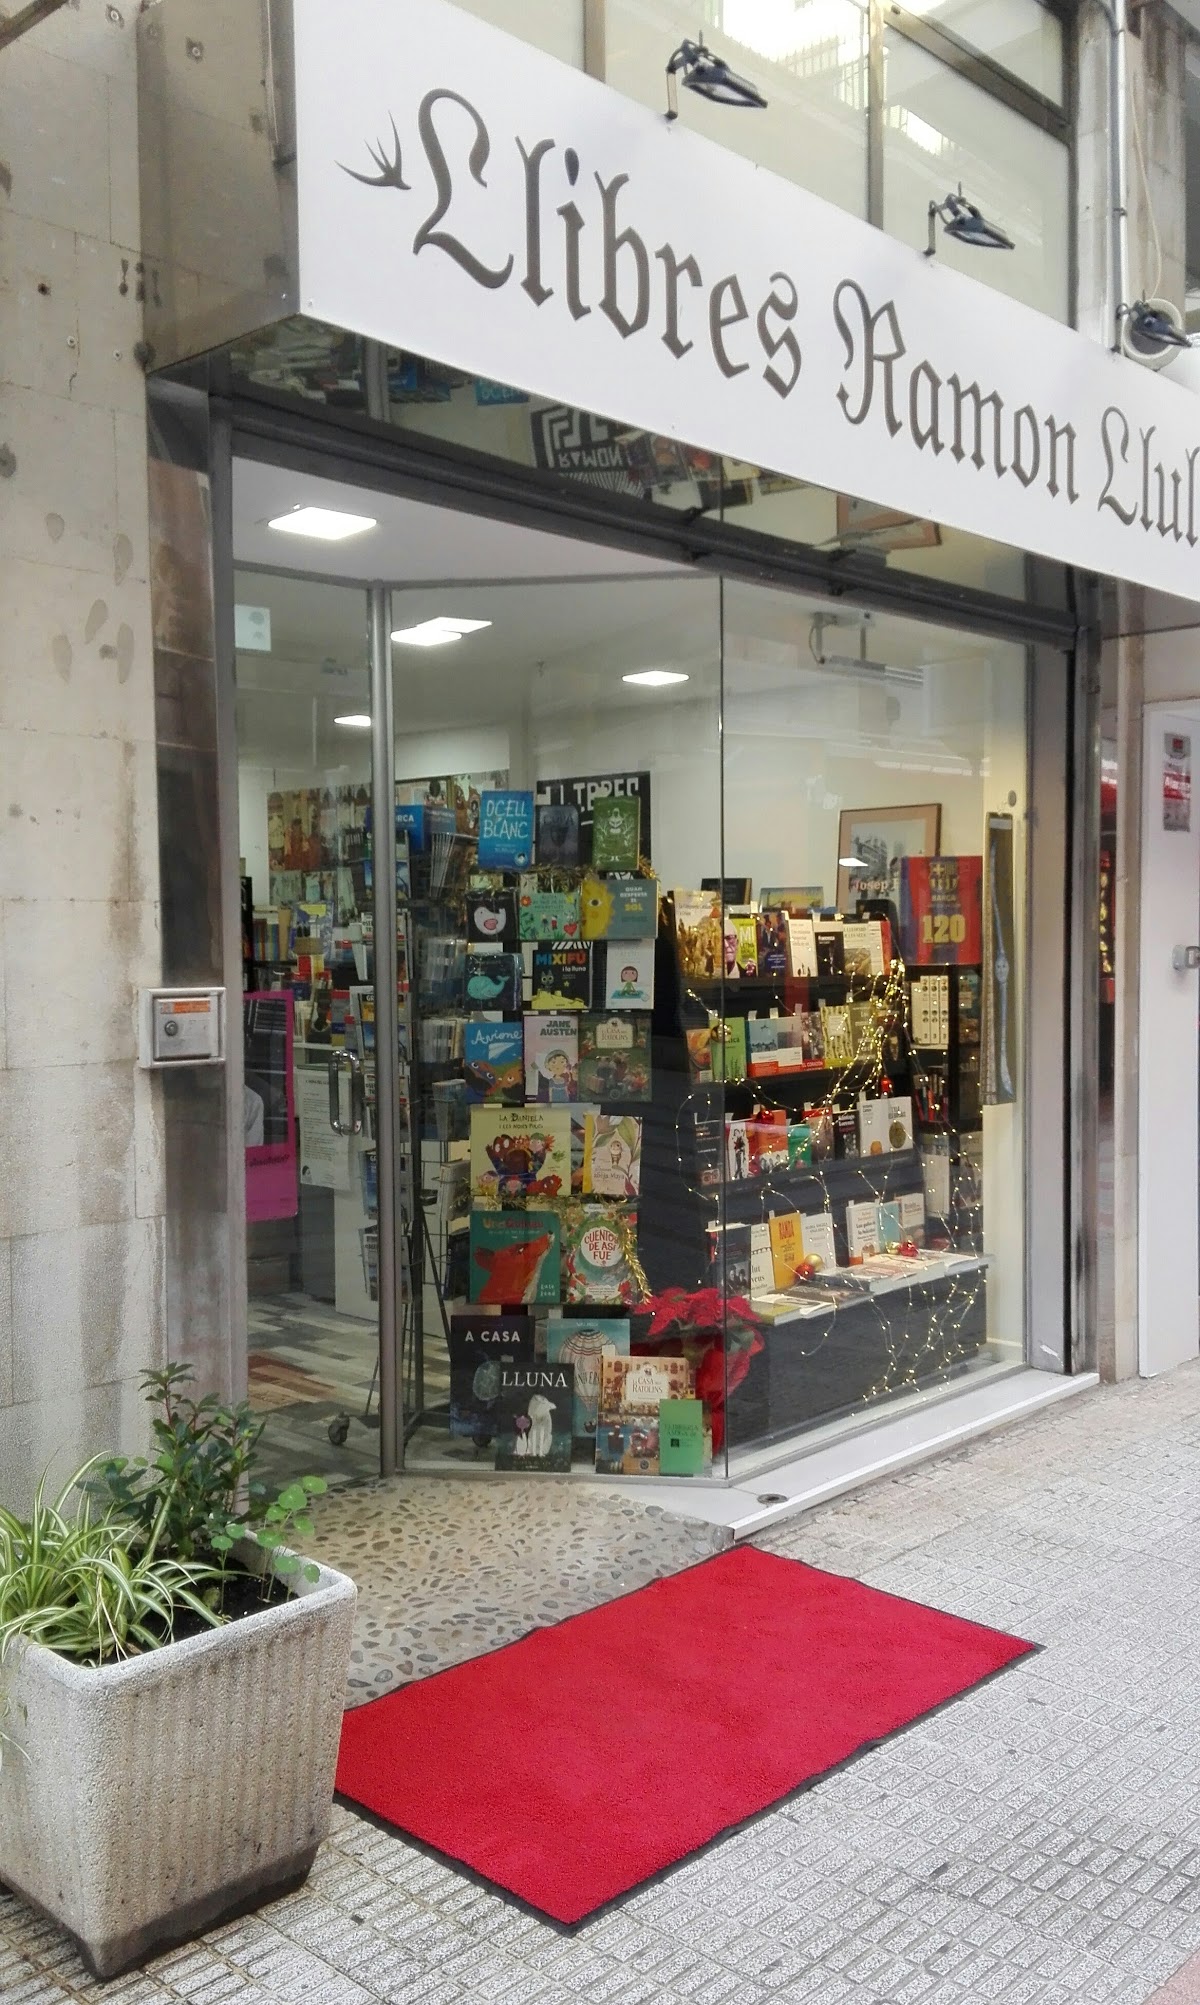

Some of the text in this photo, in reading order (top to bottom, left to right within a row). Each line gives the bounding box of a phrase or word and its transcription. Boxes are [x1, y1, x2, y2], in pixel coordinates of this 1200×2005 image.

[413, 88, 802, 400] Llibres
[833, 278, 1079, 505] Ramon
[486, 799, 528, 818] OCELL
[483, 820, 529, 840] BLANC
[852, 878, 889, 893] Josep
[921, 913, 966, 944] 120
[546, 1020, 571, 1028] JANE
[540, 1028, 577, 1036] AUSTEN
[584, 1229, 618, 1244] CUENTOS
[593, 1251, 611, 1260] FUE
[464, 1330, 521, 1343] A CASA
[501, 1371, 568, 1388] LLUNA
